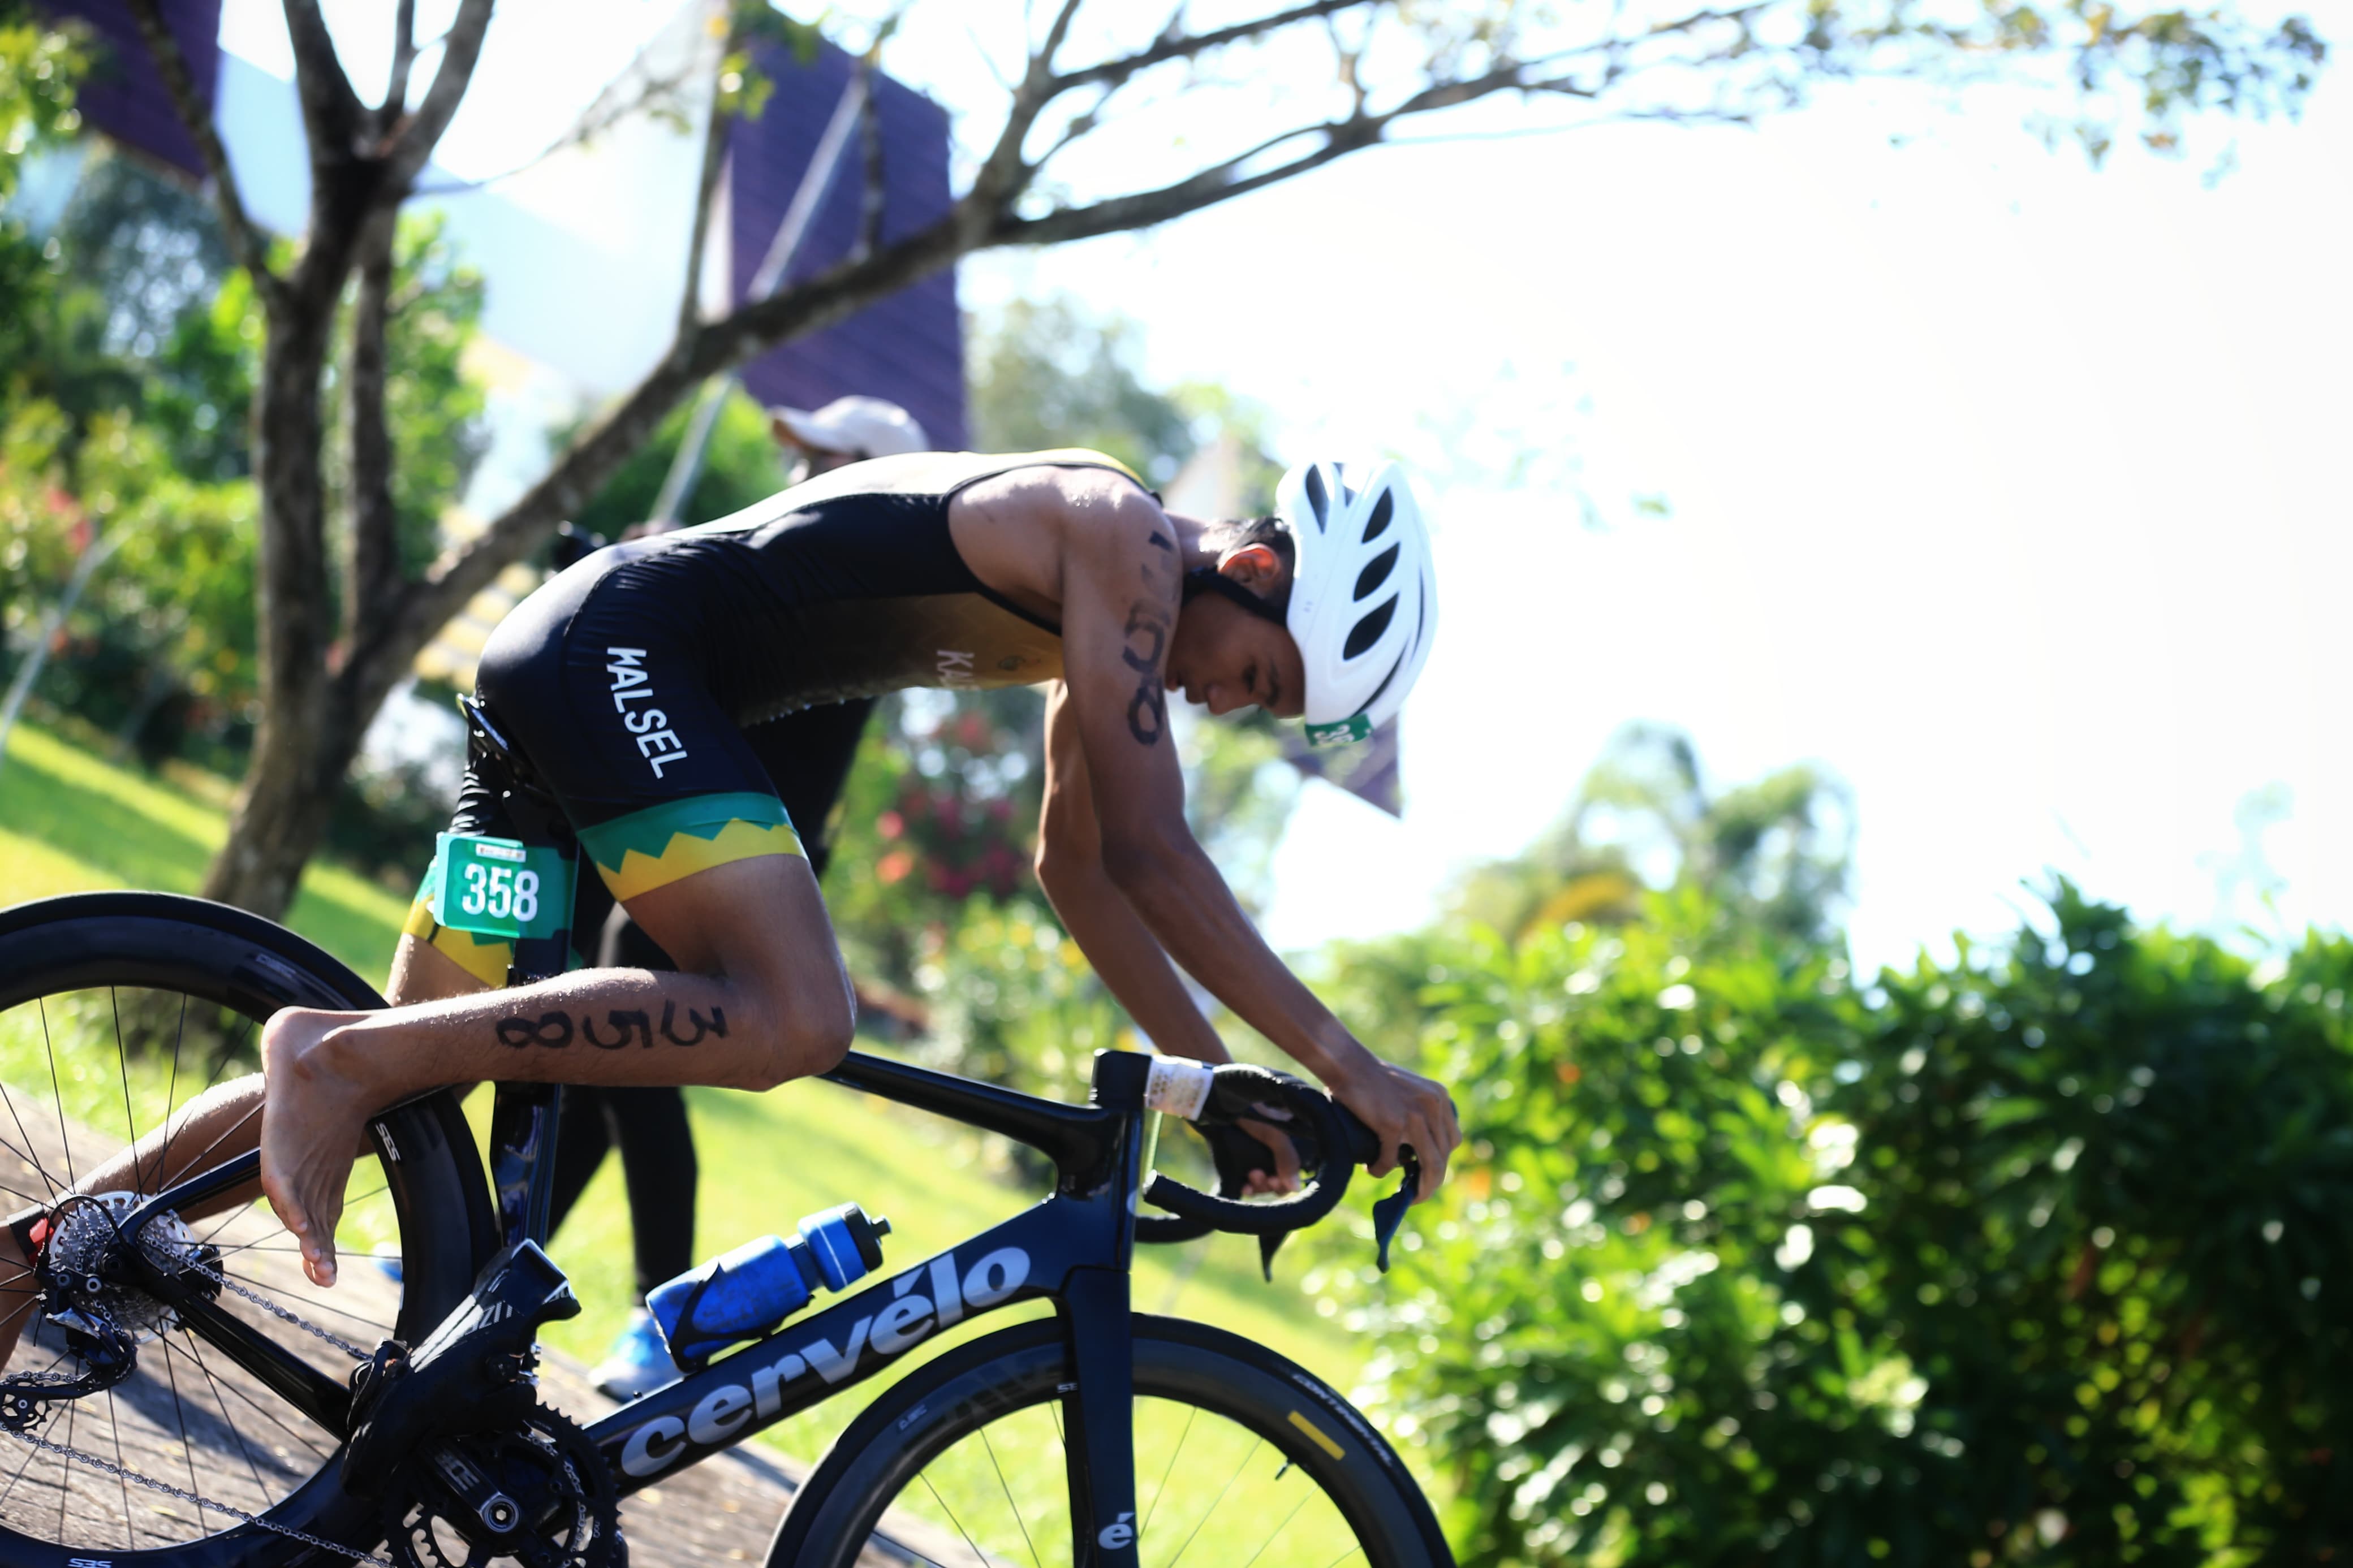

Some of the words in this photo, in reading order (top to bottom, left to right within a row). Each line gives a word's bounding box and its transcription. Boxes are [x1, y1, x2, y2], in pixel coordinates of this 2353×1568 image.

[607, 647, 687, 779] KALSEL
[462, 862, 539, 922] 358
[375, 1122, 400, 1161] SES
[622, 1247, 1030, 1476] cervélo
[1098, 1511, 1135, 1549] é
